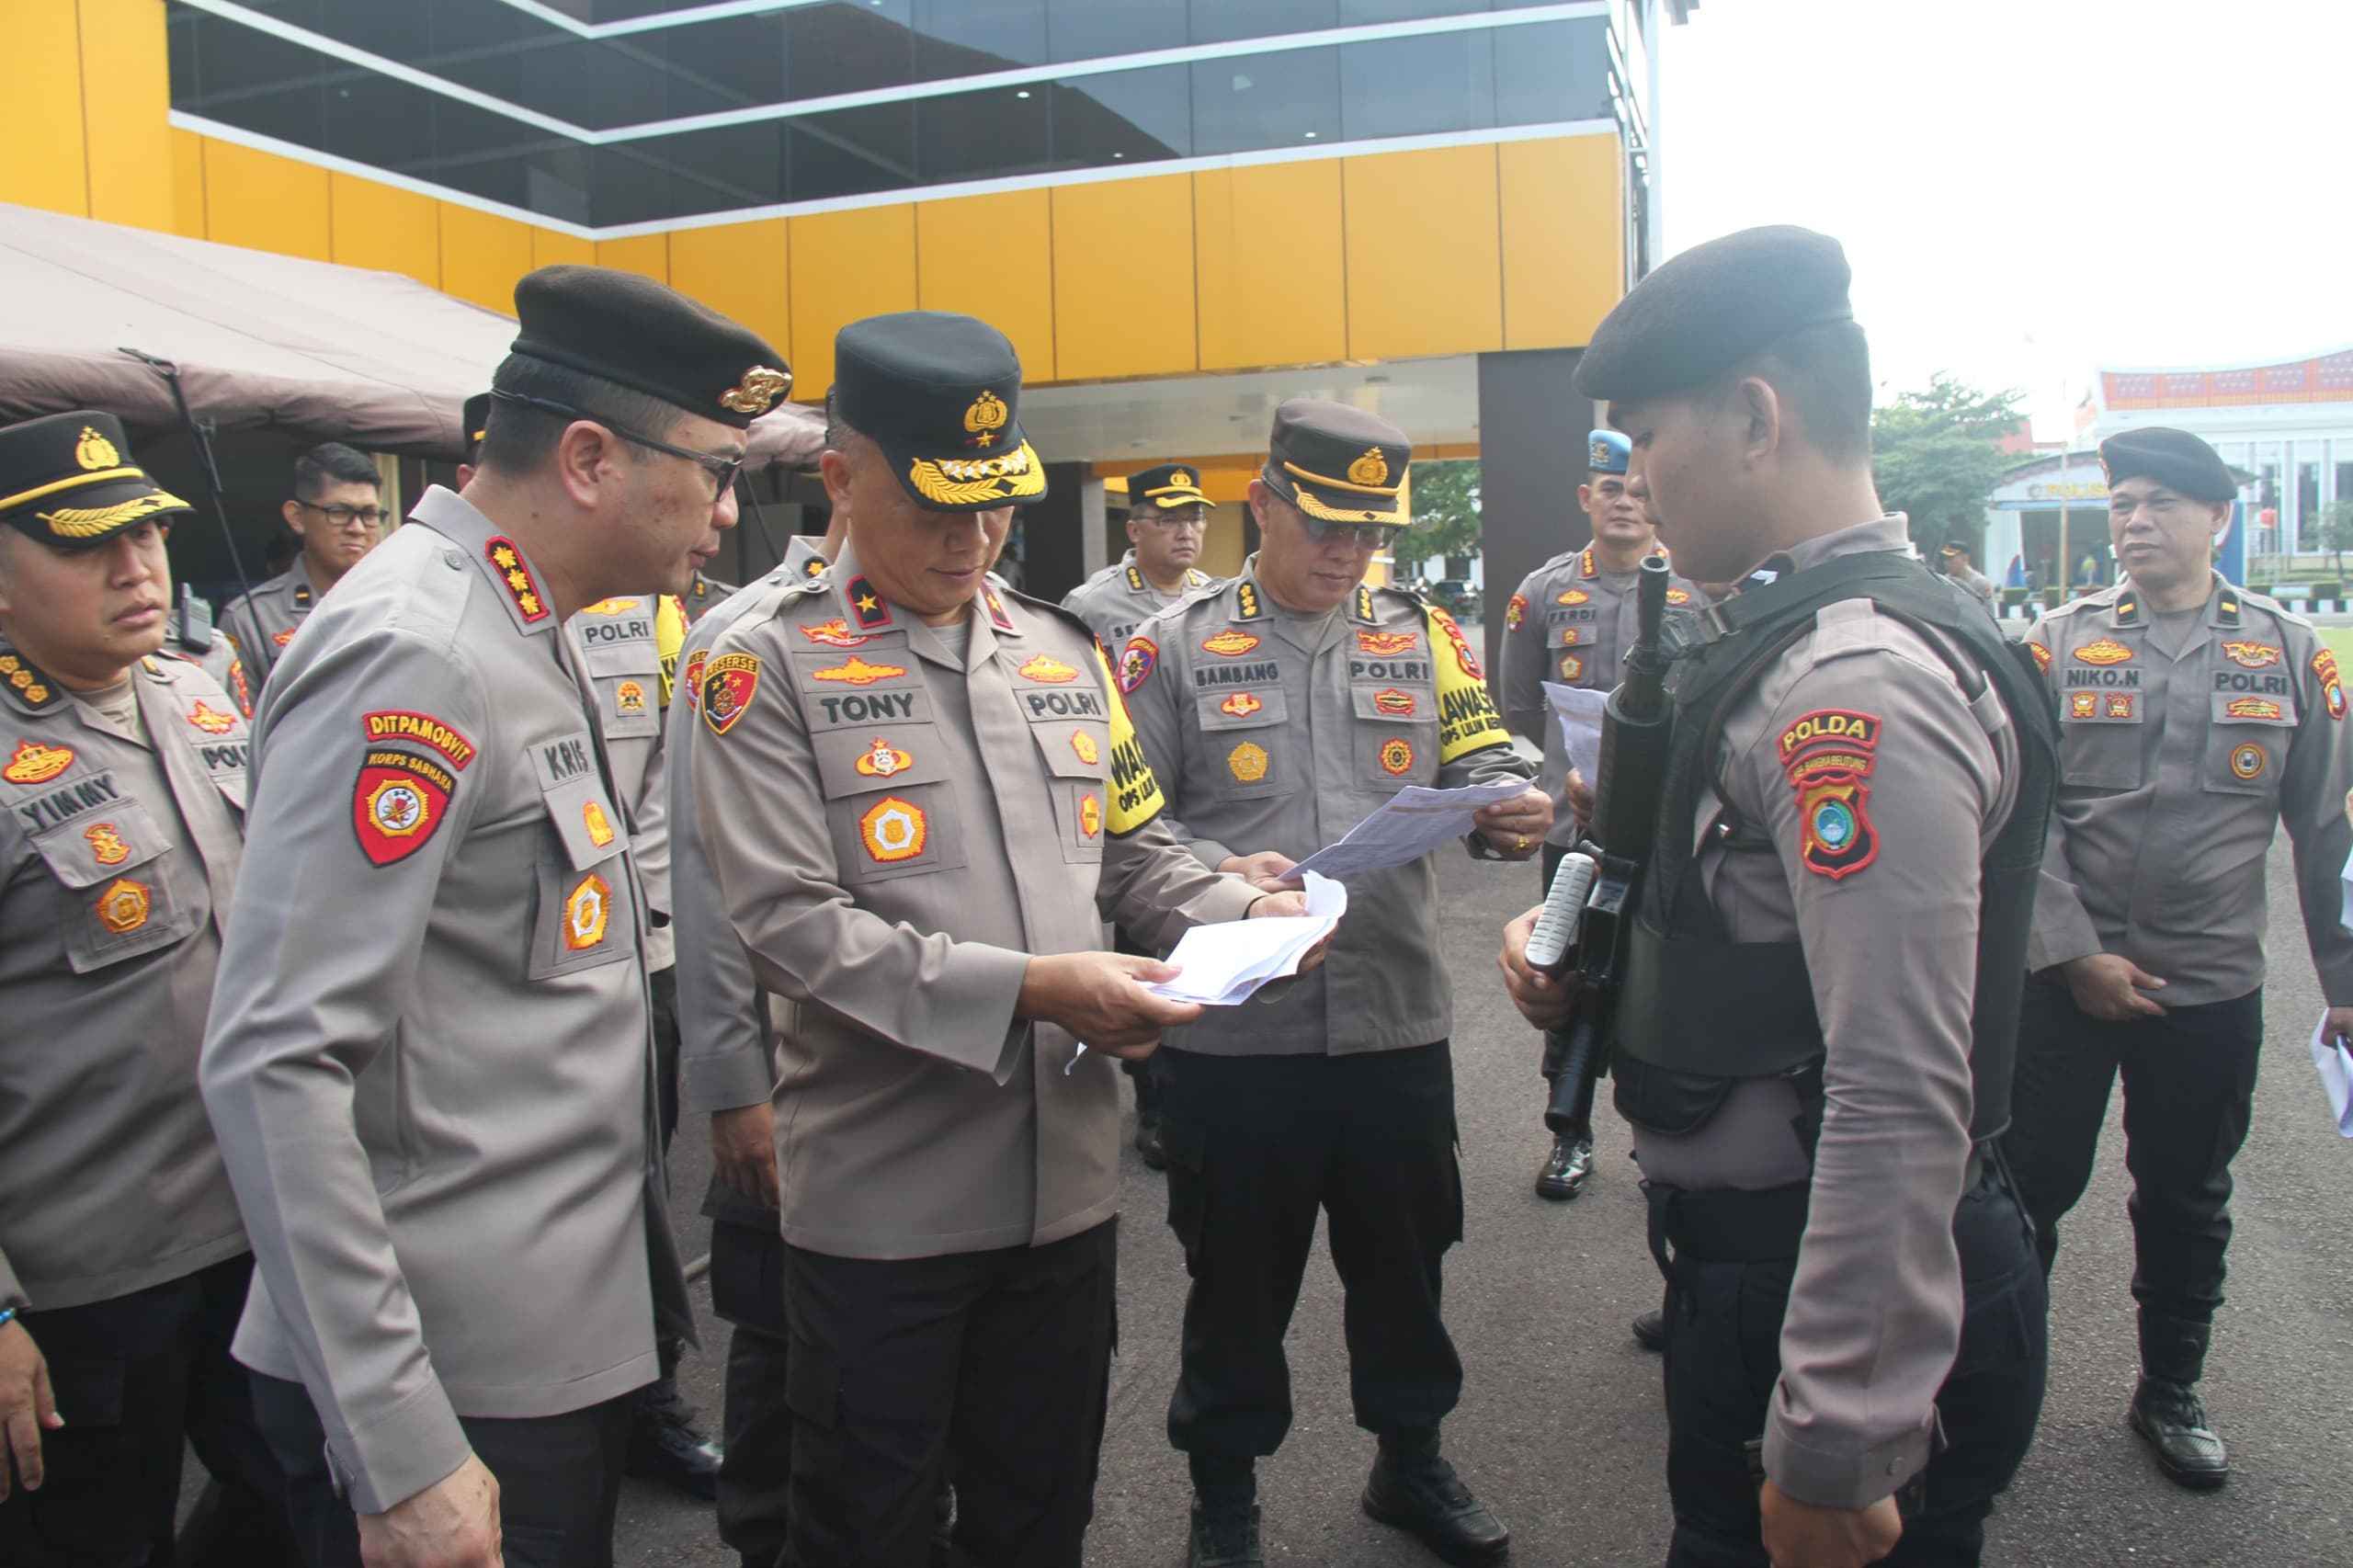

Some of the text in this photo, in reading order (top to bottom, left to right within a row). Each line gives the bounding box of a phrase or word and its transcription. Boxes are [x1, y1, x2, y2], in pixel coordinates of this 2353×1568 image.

[1550, 608, 1597, 624] FERDI
[585, 620, 650, 644] POLRI
[1196, 662, 1279, 687] BAMBANG
[1349, 661, 1429, 680] POLRI
[2067, 669, 2140, 687] NIKO.N
[2214, 672, 2287, 694] POLRI
[821, 693, 914, 723] TONY
[1027, 691, 1101, 717] POLRI
[369, 715, 471, 761] DITPAMOBVIT
[1782, 715, 1867, 752] POLDA
[369, 753, 407, 766] KORPS
[544, 739, 589, 782] KRIS
[21, 773, 119, 829] YIMMY
[1118, 788, 1140, 812] OPS
